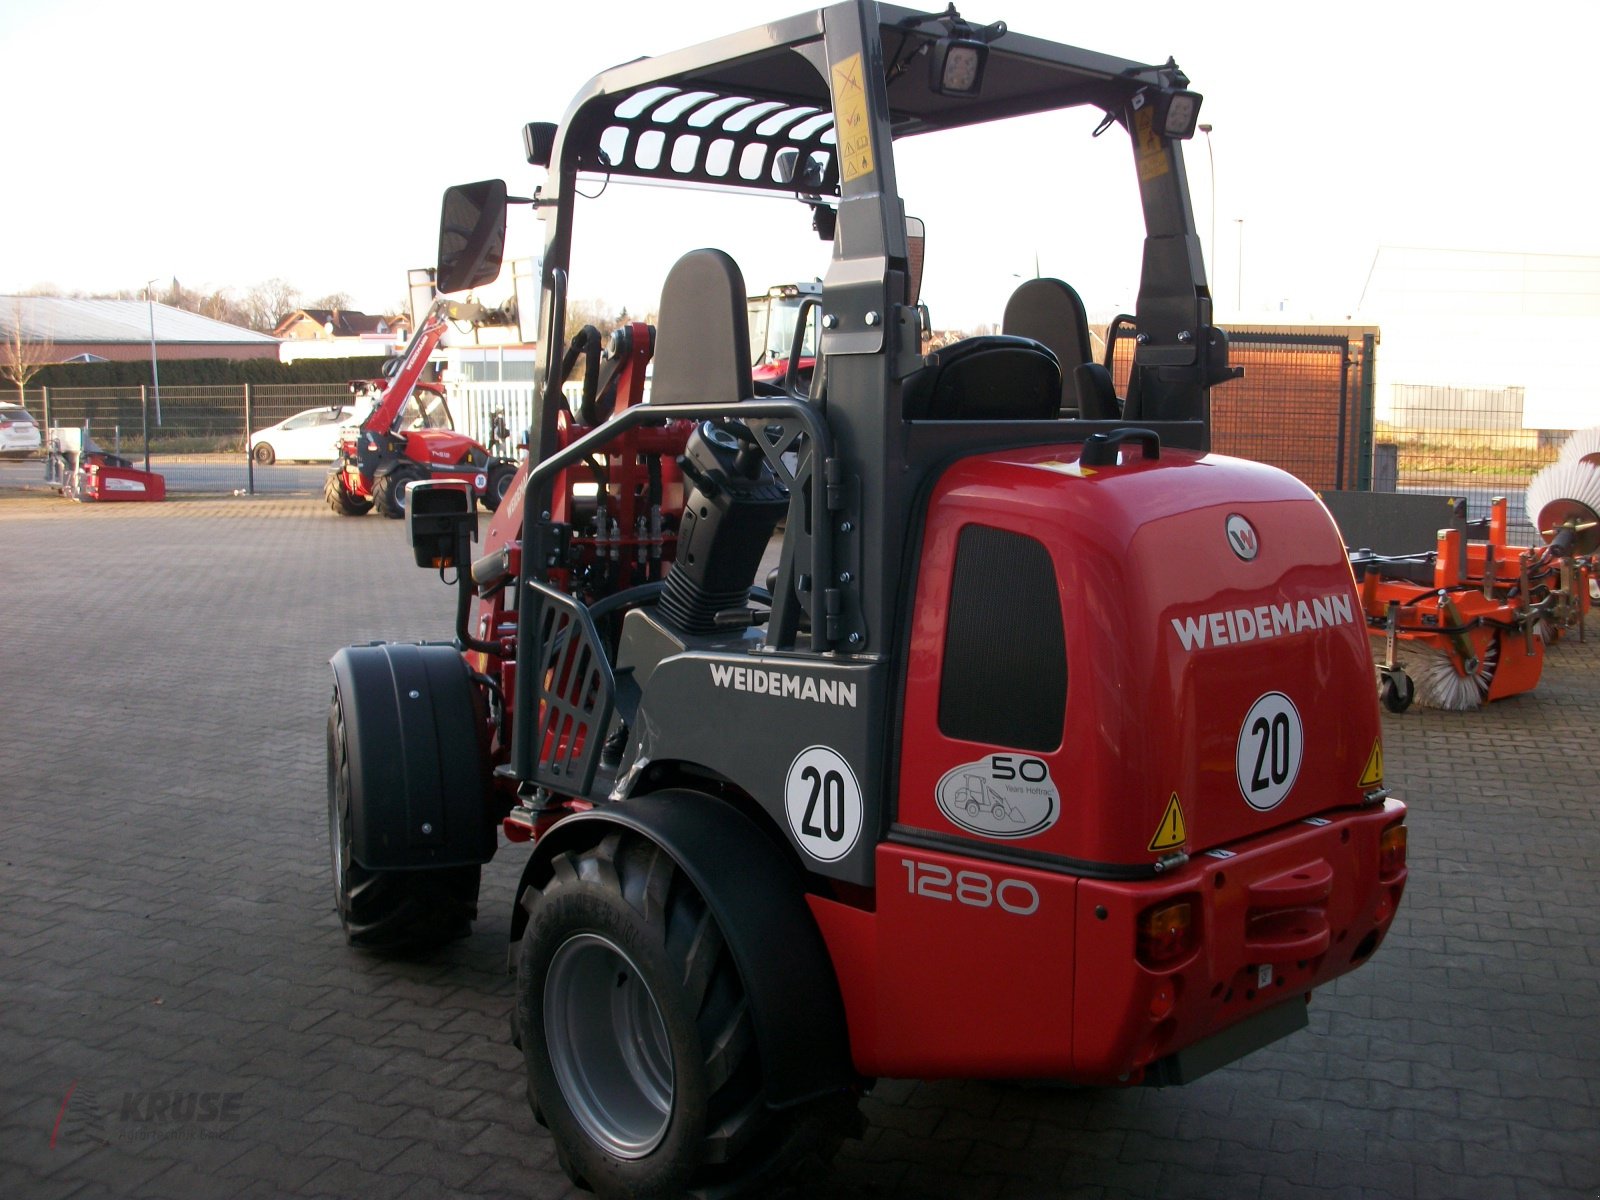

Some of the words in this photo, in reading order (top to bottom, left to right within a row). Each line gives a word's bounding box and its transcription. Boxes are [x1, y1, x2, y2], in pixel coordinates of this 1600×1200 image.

[1171, 593, 1354, 652] WEIDEMANN
[709, 663, 857, 708] WEIDEMANN
[991, 755, 1048, 783] 50
[1251, 711, 1290, 793] 20
[800, 765, 845, 842] 20
[1005, 784, 1024, 794] Years
[901, 858, 1040, 916] 1280
